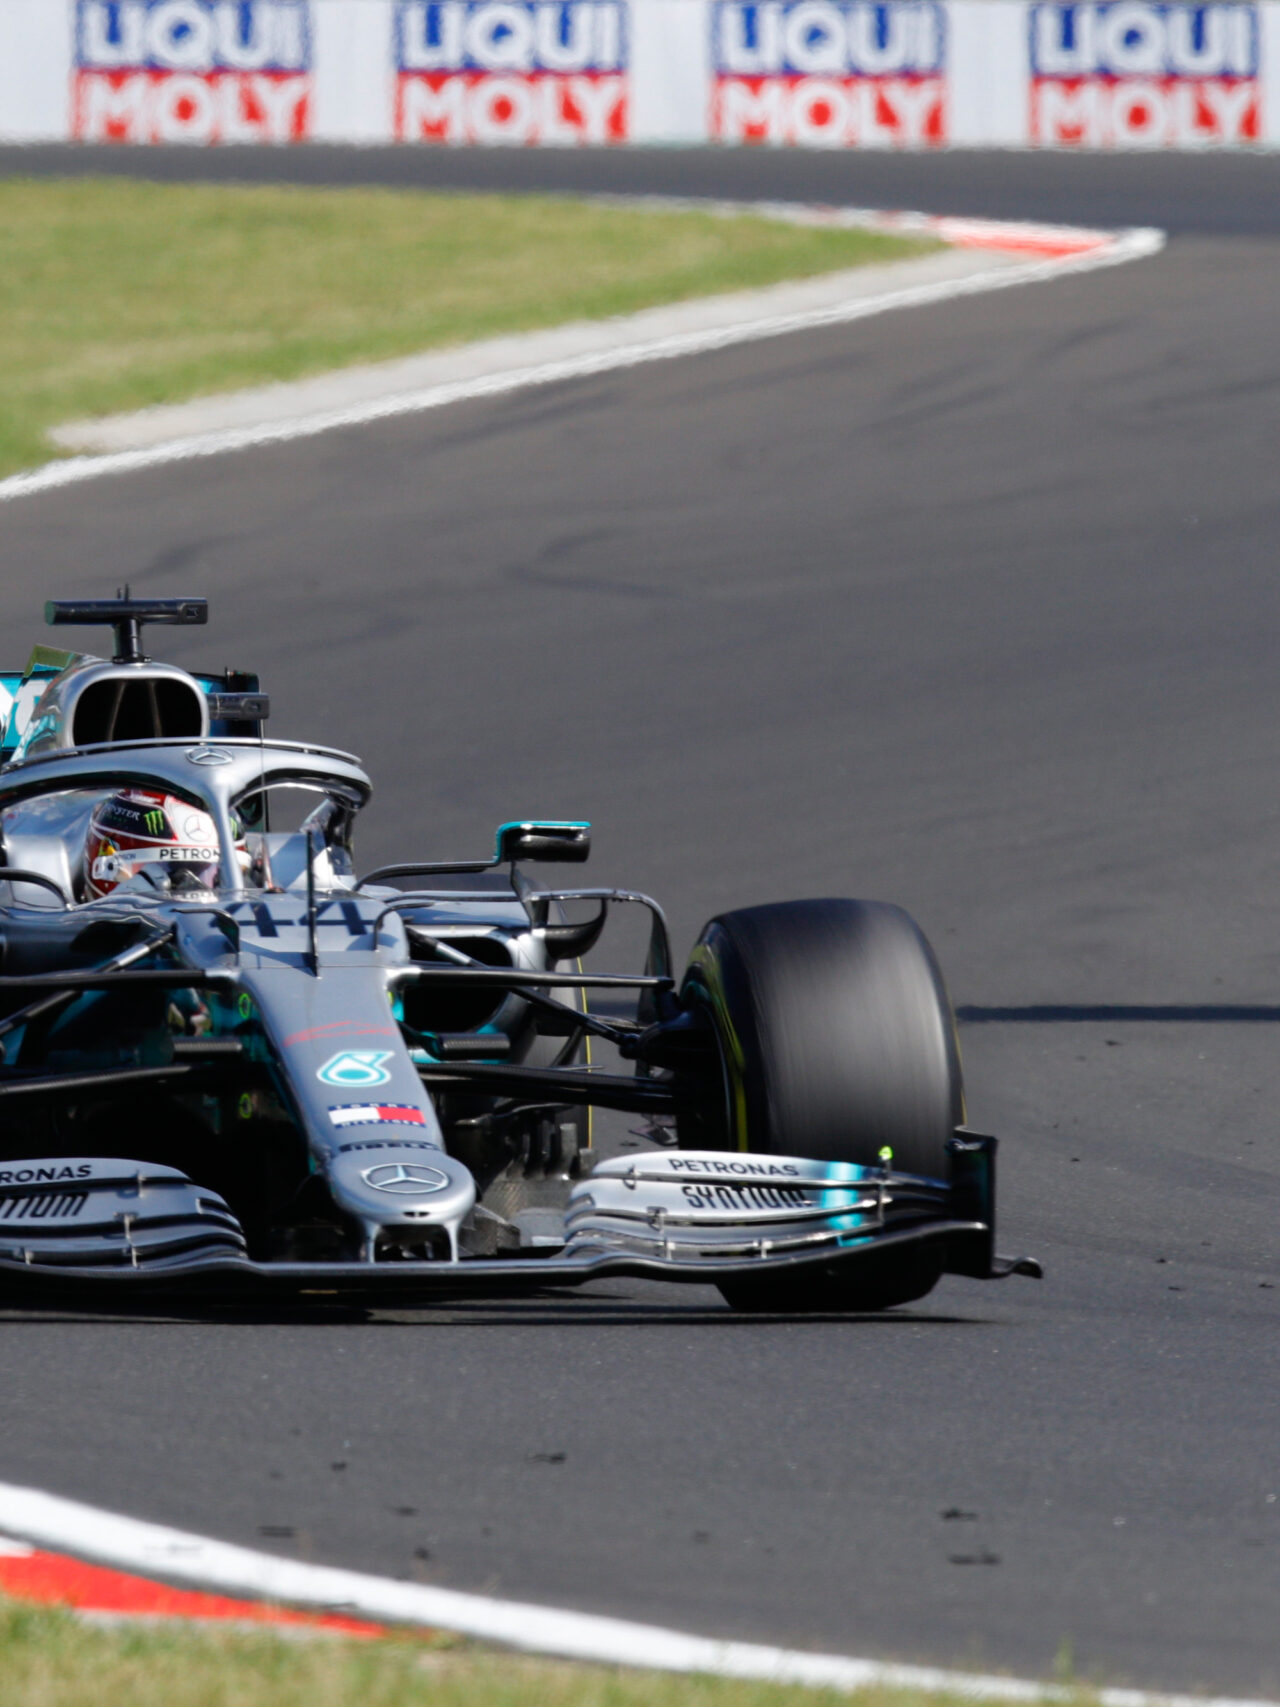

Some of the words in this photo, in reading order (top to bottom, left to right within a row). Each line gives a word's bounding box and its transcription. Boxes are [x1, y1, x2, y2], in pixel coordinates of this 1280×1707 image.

[85, 1, 304, 67] LIQUI
[403, 2, 621, 69] LIQUI
[721, 3, 936, 72] LIQUI
[1036, 4, 1251, 72] LIQUI
[86, 74, 306, 140] MOLY
[403, 75, 625, 143] MOLY
[722, 78, 940, 143] MOLY
[1038, 79, 1254, 144] MOLY
[209, 902, 376, 938] 44
[668, 1158, 800, 1177] PETRONAS
